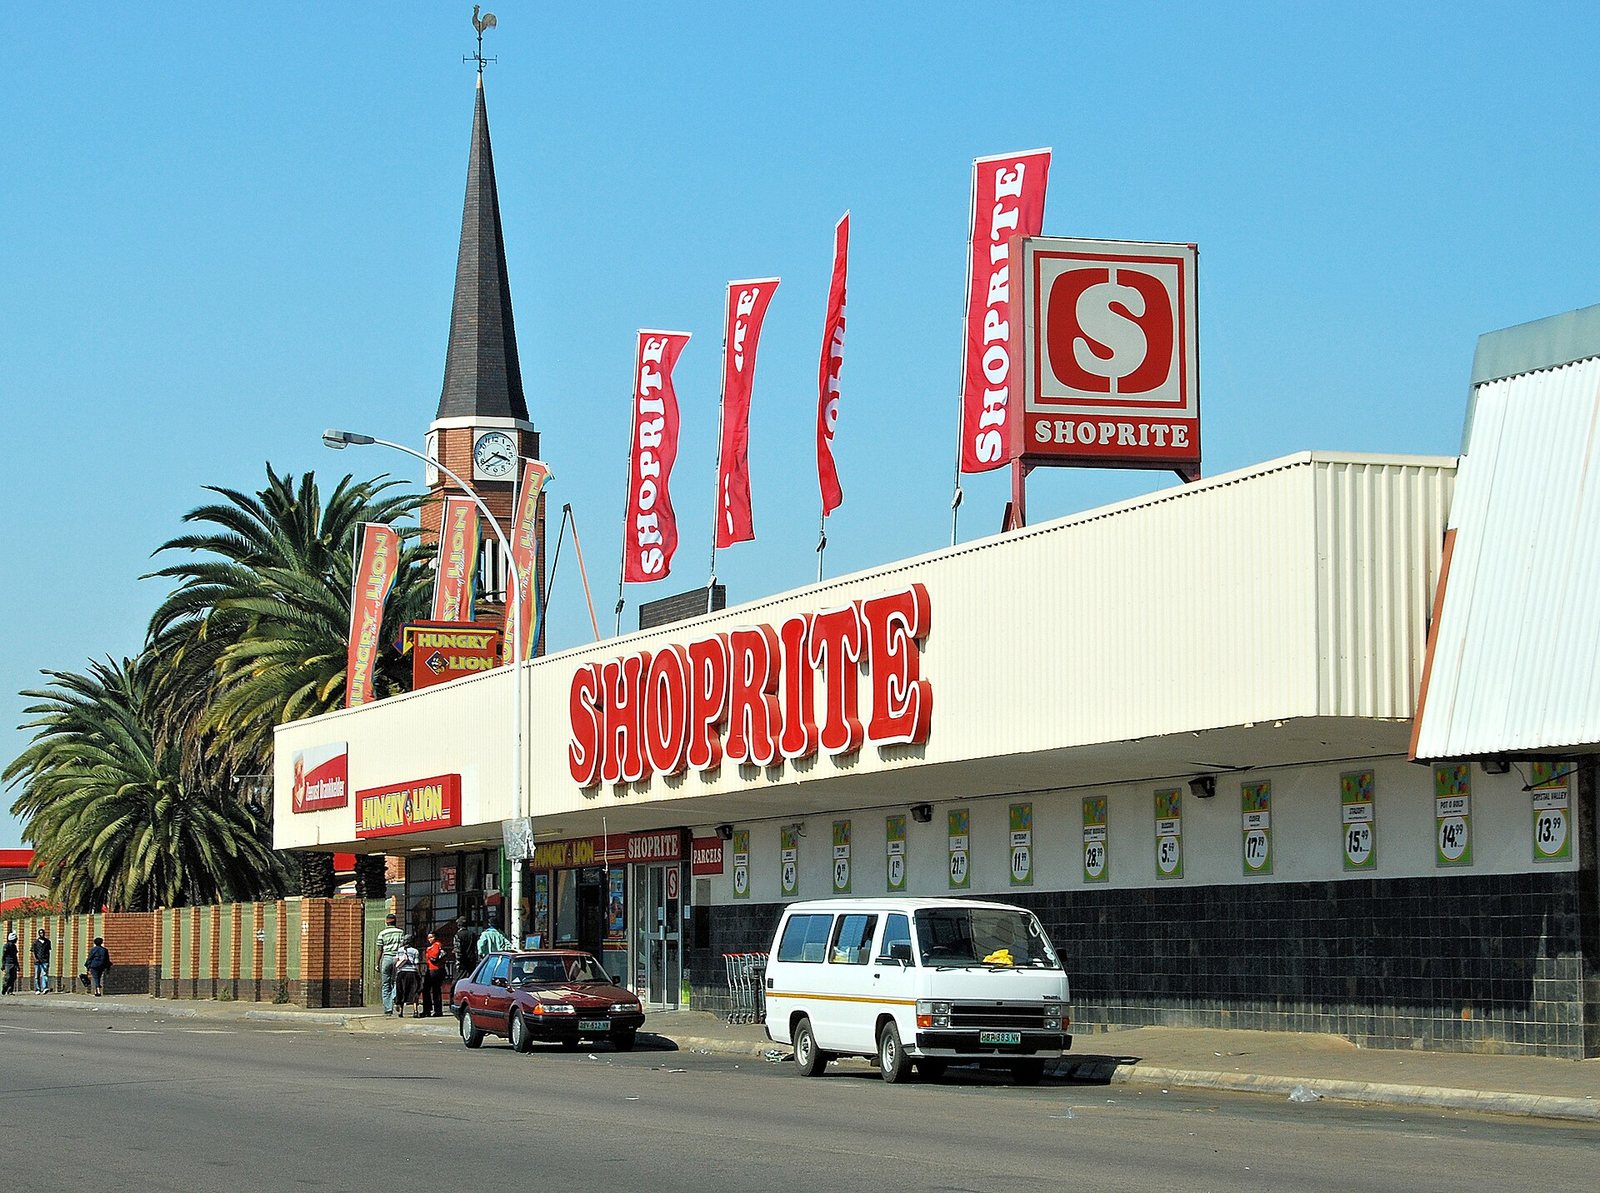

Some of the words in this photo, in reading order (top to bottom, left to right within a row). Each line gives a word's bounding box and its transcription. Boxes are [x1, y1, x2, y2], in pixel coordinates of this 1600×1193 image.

[975, 162, 1026, 463] SHOPRITE
[635, 336, 670, 576] SHOPRITE
[1034, 419, 1190, 449] SHOPRITE
[519, 471, 541, 550] LION
[365, 532, 388, 601] LION
[446, 506, 469, 580] LION
[417, 633, 494, 650] HUNGRY
[448, 655, 494, 671] LION
[568, 582, 933, 789] SHOPRITE
[362, 790, 410, 831] HUNGRY
[412, 784, 443, 824] LION
[534, 842, 568, 868] HUNGRY
[572, 839, 594, 865] LION
[627, 834, 680, 859] SHOPRITE
[693, 848, 722, 865] PARCELS
